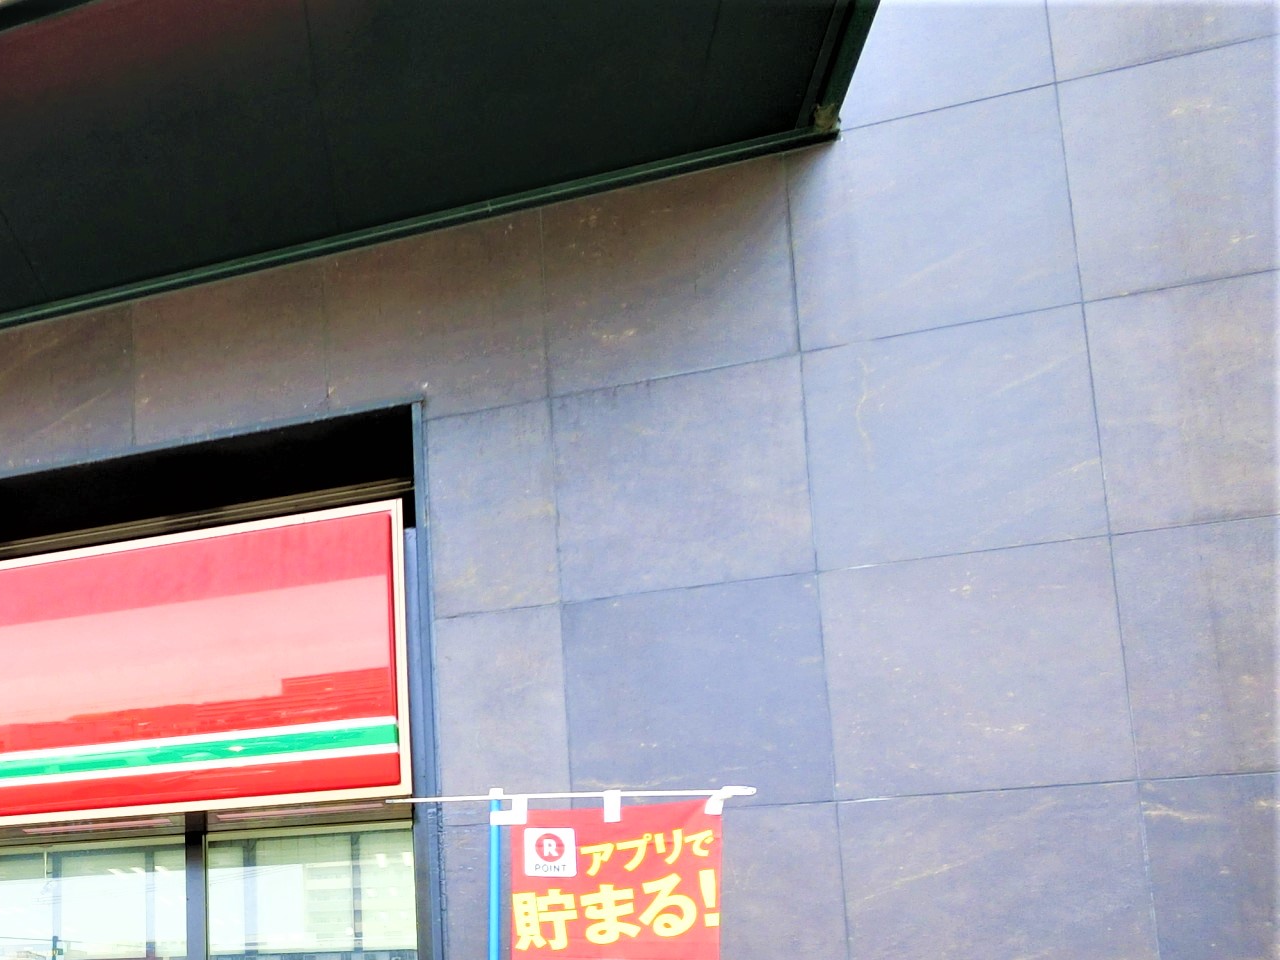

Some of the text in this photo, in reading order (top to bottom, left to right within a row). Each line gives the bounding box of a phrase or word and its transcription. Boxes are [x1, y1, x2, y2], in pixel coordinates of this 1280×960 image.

[534, 864, 567, 872] POINT
[579, 828, 715, 876] アプリで
[512, 869, 720, 951] 貯まる!
